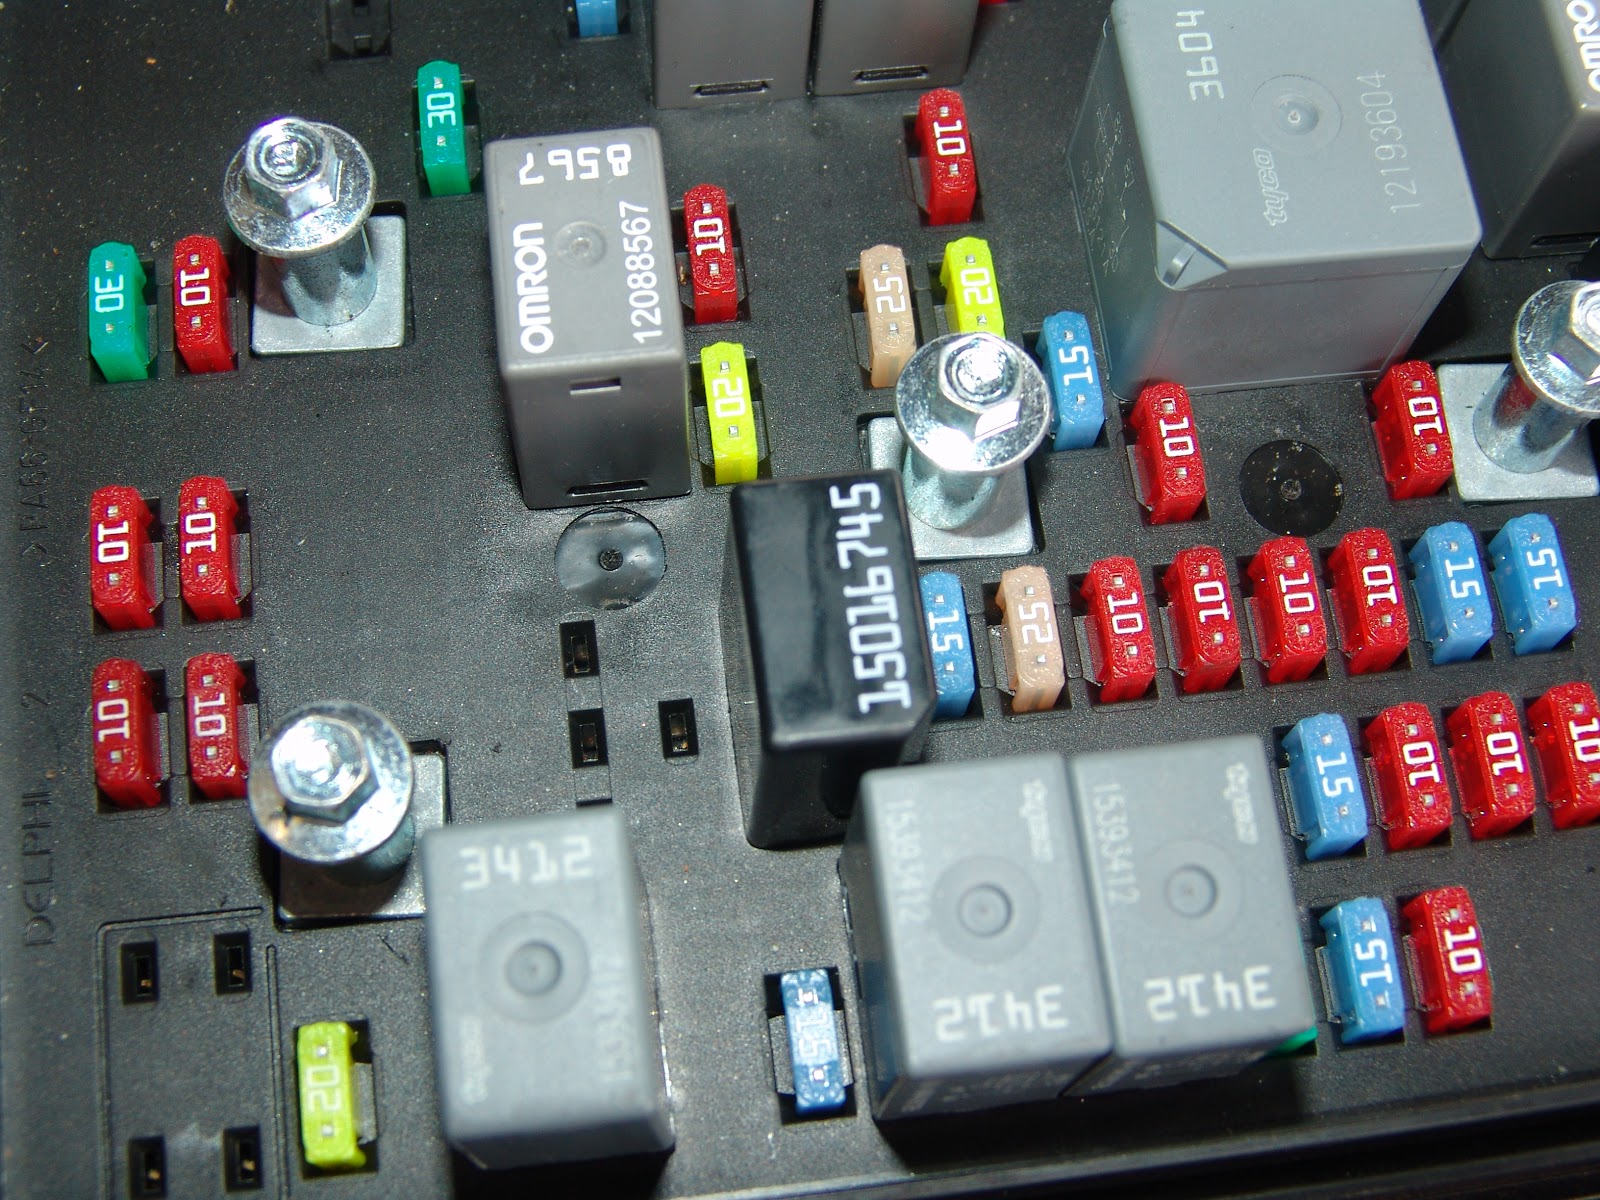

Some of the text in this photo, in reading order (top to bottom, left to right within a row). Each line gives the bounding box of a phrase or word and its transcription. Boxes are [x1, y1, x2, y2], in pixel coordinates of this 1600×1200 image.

[1175, 9, 1225, 101] 3604
[427, 91, 456, 128] 30
[933, 118, 967, 156] 10
[1356, 70, 1421, 214] 12193604
[519, 143, 632, 186] 8567
[1252, 147, 1290, 227] tyco
[693, 217, 725, 256] 10
[94, 273, 124, 313] 30
[180, 267, 209, 307] 10
[514, 222, 554, 354] OMRON
[618, 200, 663, 344] 12088567
[960, 267, 993, 306] 20
[874, 276, 906, 314] 25
[1058, 344, 1093, 387] 15
[711, 378, 746, 418] 20
[1407, 395, 1442, 436] 10
[1159, 416, 1194, 458] 10
[97, 521, 129, 563] 10
[185, 511, 216, 554] 10
[1362, 564, 1397, 605] 10
[1444, 556, 1481, 599] 15
[1527, 547, 1562, 590] 15
[829, 482, 912, 715] 15016745
[1107, 592, 1143, 635] 10
[1194, 580, 1230, 622] 10
[1280, 571, 1315, 614] 10
[927, 609, 964, 654] 15
[1017, 600, 1053, 647] 25
[98, 697, 130, 743] 10
[193, 692, 227, 737] 10
[1316, 751, 1354, 798] 15
[1402, 741, 1441, 786] 10
[1486, 731, 1524, 776] 10
[459, 835, 593, 890] 3412
[1355, 938, 1393, 987] 15
[1444, 926, 1483, 973] 10
[932, 985, 1069, 1043] 3412
[1145, 965, 1277, 1022] 3412
[795, 1007, 832, 1059] 15
[306, 1064, 341, 1112] 20
